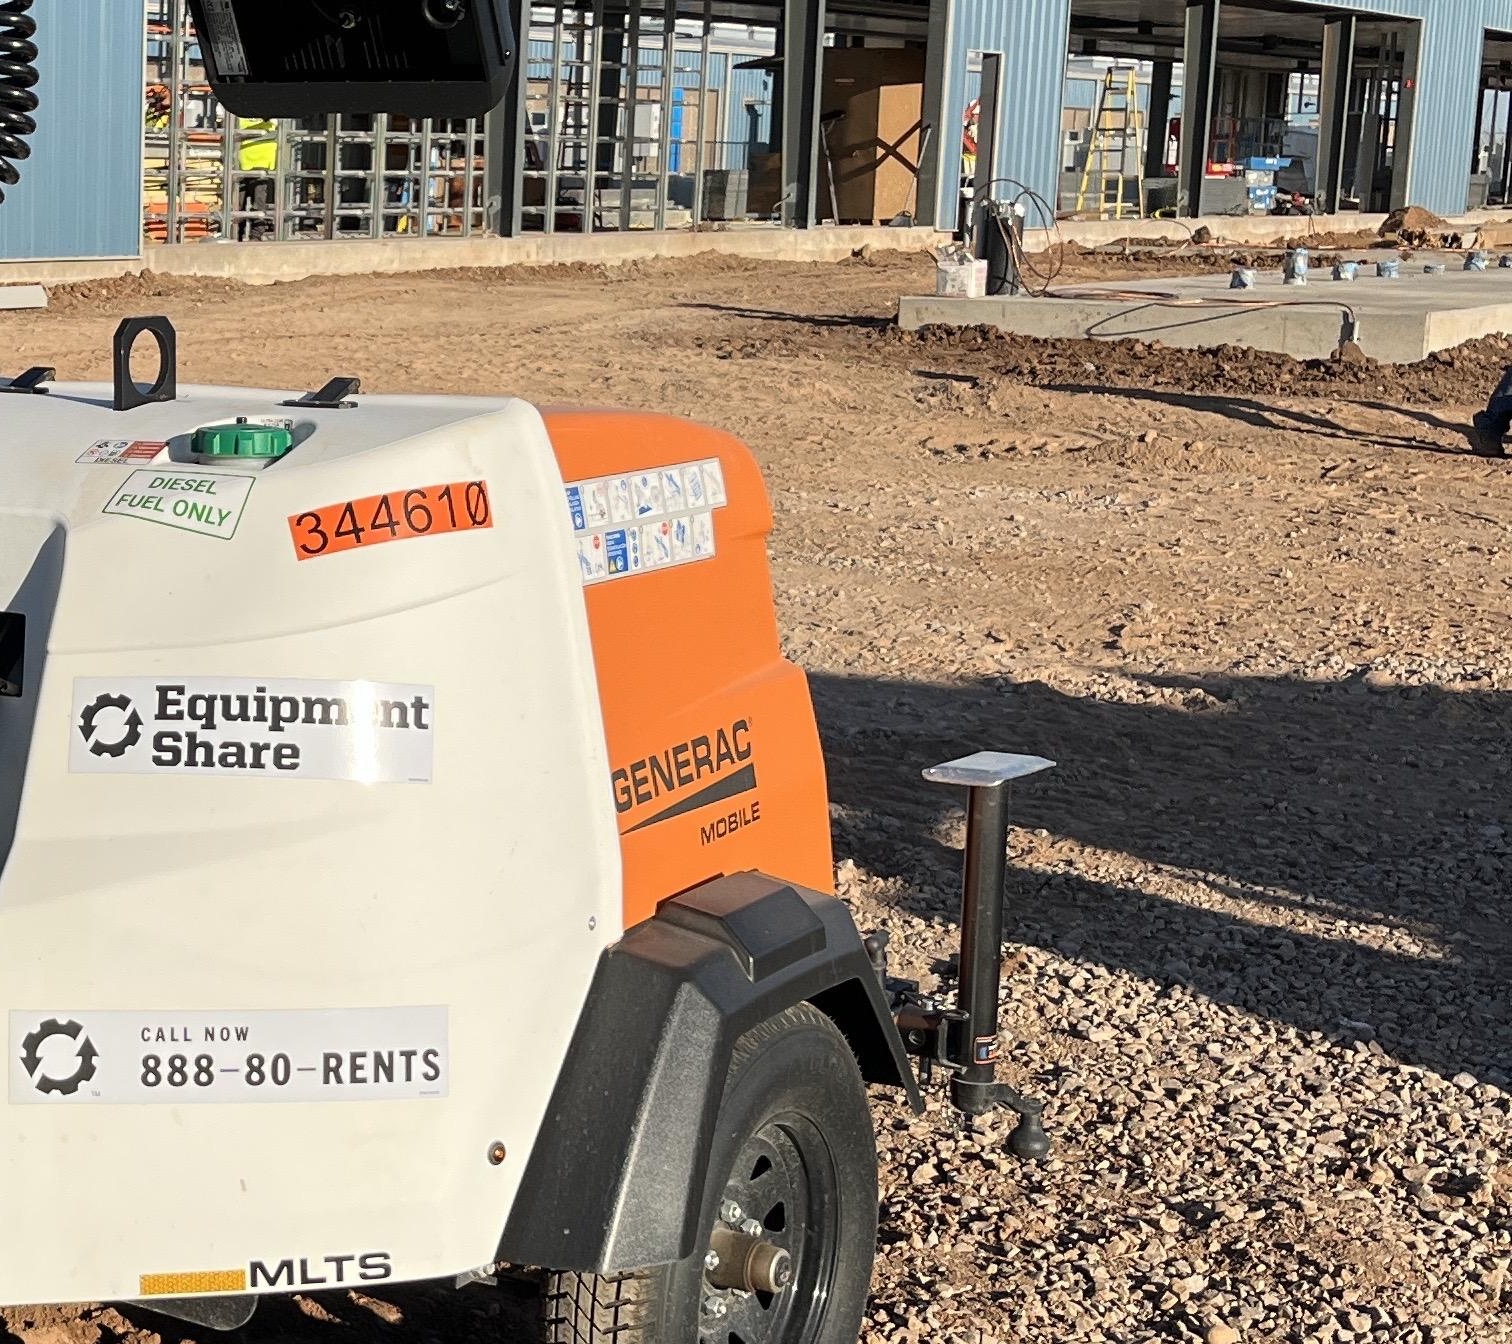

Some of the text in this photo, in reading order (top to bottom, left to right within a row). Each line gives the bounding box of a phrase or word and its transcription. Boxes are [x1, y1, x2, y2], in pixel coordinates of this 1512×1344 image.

[147, 476, 217, 496] DIESEL
[115, 493, 232, 527] FUEL ONLY
[296, 480, 489, 555] 344610
[154, 684, 430, 732] Equipmnt
[151, 730, 301, 770] Share
[610, 719, 752, 814] GENERAC
[700, 800, 761, 846] MOBILE
[140, 1025, 249, 1042] CALL NOW
[140, 1048, 441, 1087] 888-80-RENTS
[249, 1252, 392, 1288] MLTS
